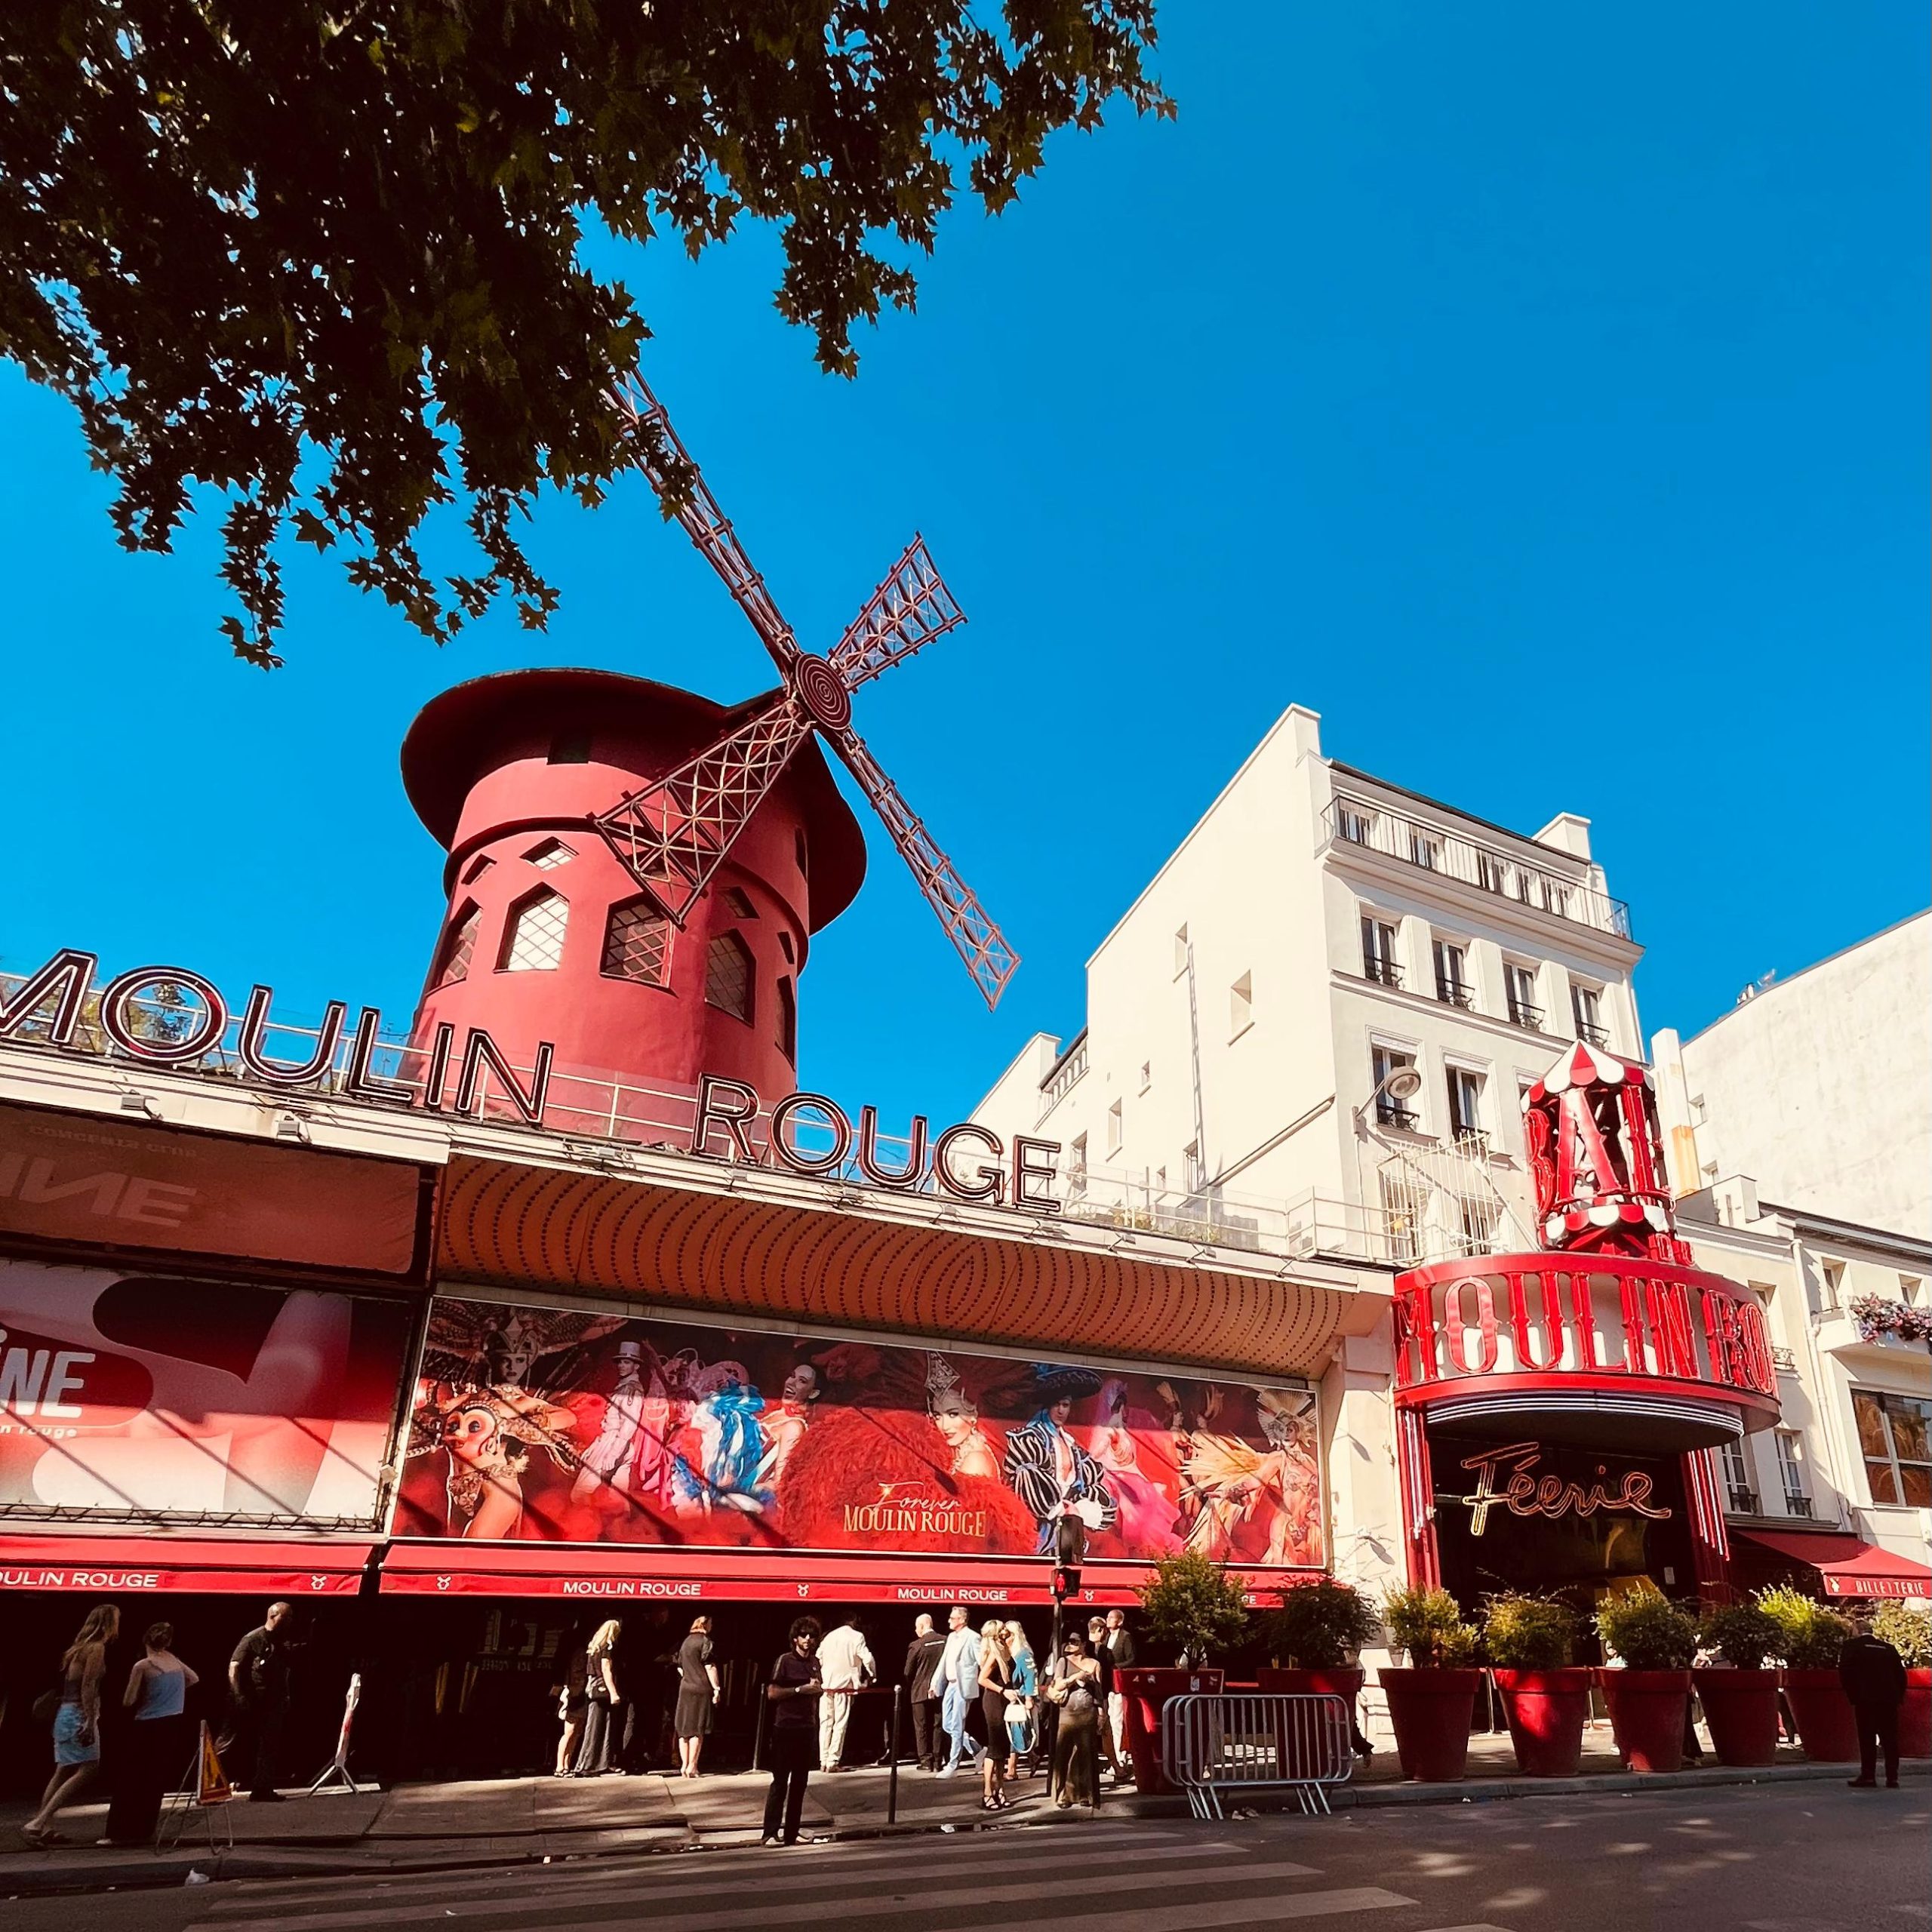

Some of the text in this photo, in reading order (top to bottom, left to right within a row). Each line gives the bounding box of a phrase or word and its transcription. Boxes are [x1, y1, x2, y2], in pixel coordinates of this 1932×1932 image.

[692, 1072, 1062, 1213] ROUGE
[1393, 1270, 1700, 1386] MOULIN
[866, 1481, 961, 1515] Forever
[1461, 1441, 1672, 1537] Féerie
[843, 1504, 986, 1537] MOULIN ROUGE
[0, 1571, 159, 1588] ULIN ROUGE
[563, 1582, 702, 1596] MOULIN ROUGE
[897, 1587, 1008, 1601] MOULIN ROUGE
